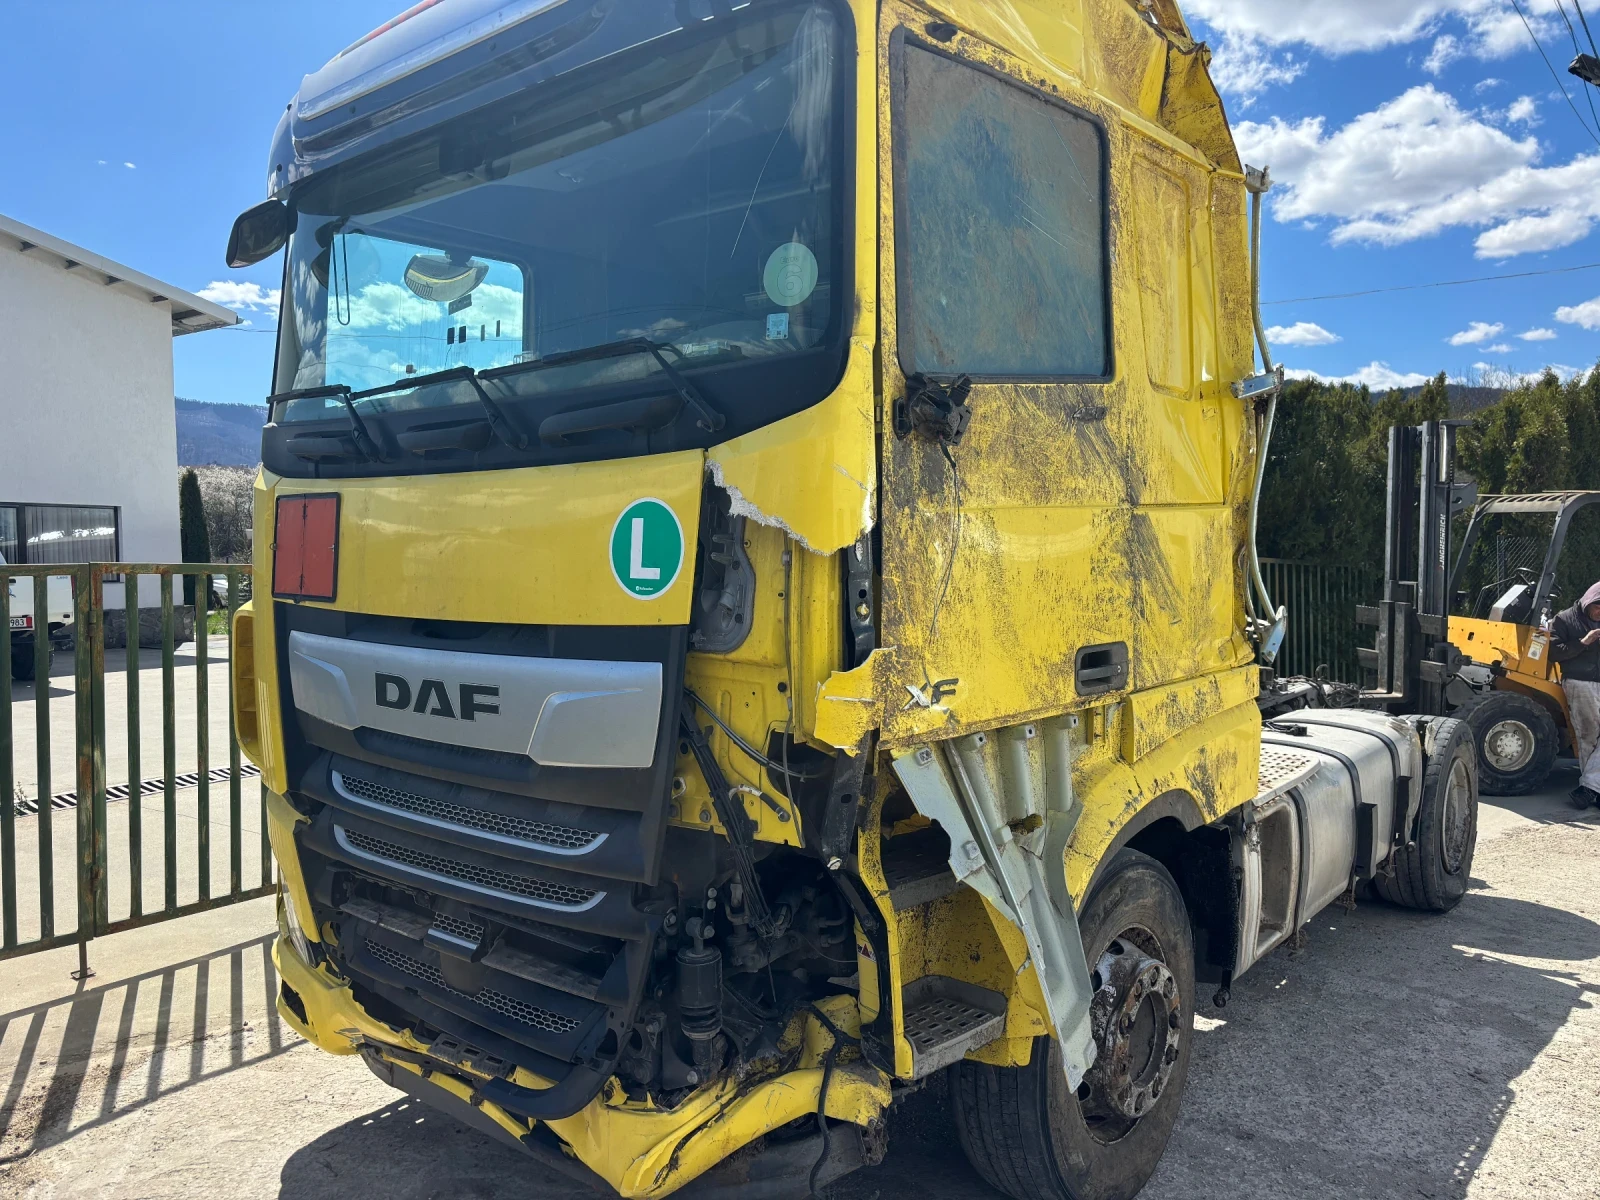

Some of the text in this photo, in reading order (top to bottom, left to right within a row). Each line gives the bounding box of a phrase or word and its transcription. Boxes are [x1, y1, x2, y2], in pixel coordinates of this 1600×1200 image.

[630, 518, 660, 580] L
[375, 671, 500, 722] DAF
[900, 678, 959, 712] XF
